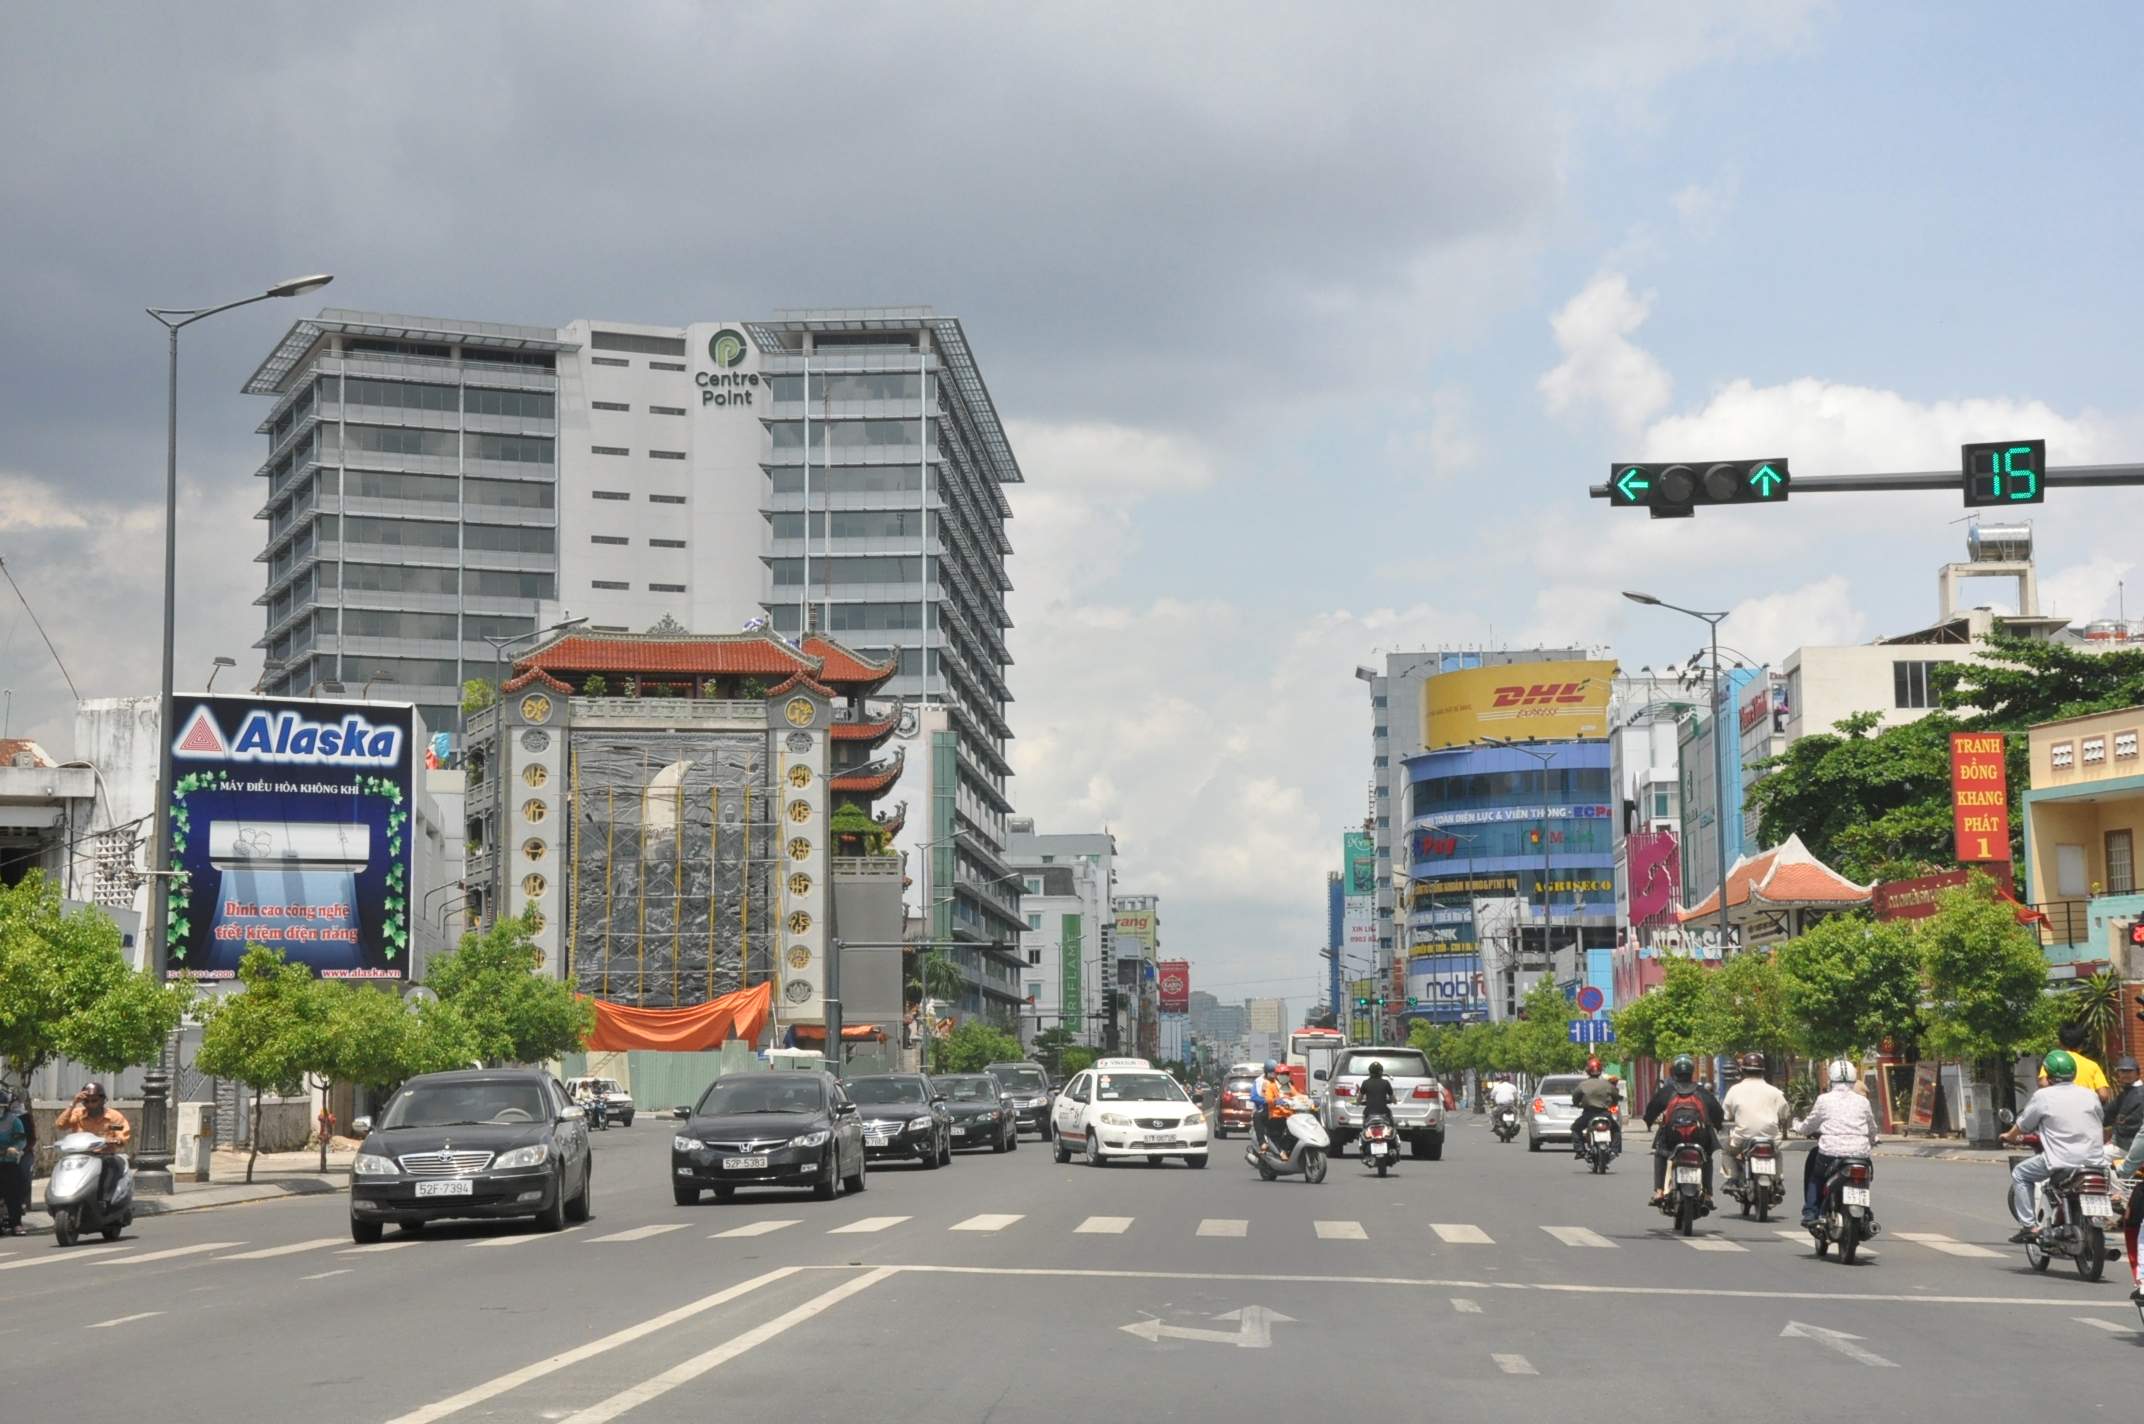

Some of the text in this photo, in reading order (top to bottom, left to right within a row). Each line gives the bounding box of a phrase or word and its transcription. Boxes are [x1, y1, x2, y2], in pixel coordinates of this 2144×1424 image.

[695, 371, 759, 387] Centre
[702, 390, 752, 406] Point
[1992, 447, 2035, 499] 15
[1493, 683, 1586, 707] DHL
[1516, 707, 1559, 718] EXPRESS
[235, 716, 395, 757] Alaska
[1955, 739, 2001, 753] TRANH
[1960, 757, 1997, 779] ĐỒNG
[220, 779, 359, 795] MÁY ĐIỀU HÒA KHÔNG KHÍ
[1957, 791, 2003, 805] KHANG
[1455, 811, 1475, 824] ĐIỆN
[1477, 811, 1494, 824] LỰC
[1496, 811, 1503, 819] &
[1964, 813, 1999, 831] PHÁT
[1977, 838, 1992, 858] 1
[1534, 881, 1612, 894] AGRISECO
[226, 902, 350, 919] Đỉnh cao công nghệ
[216, 922, 358, 942] tiết kiệm điện năng
[322, 968, 401, 978] www.alaska.vn
[1068, 934, 1077, 1026] ORIFLAME
[725, 1158, 766, 1168] 52P-5383
[419, 1183, 469, 1195] 52F-7394
